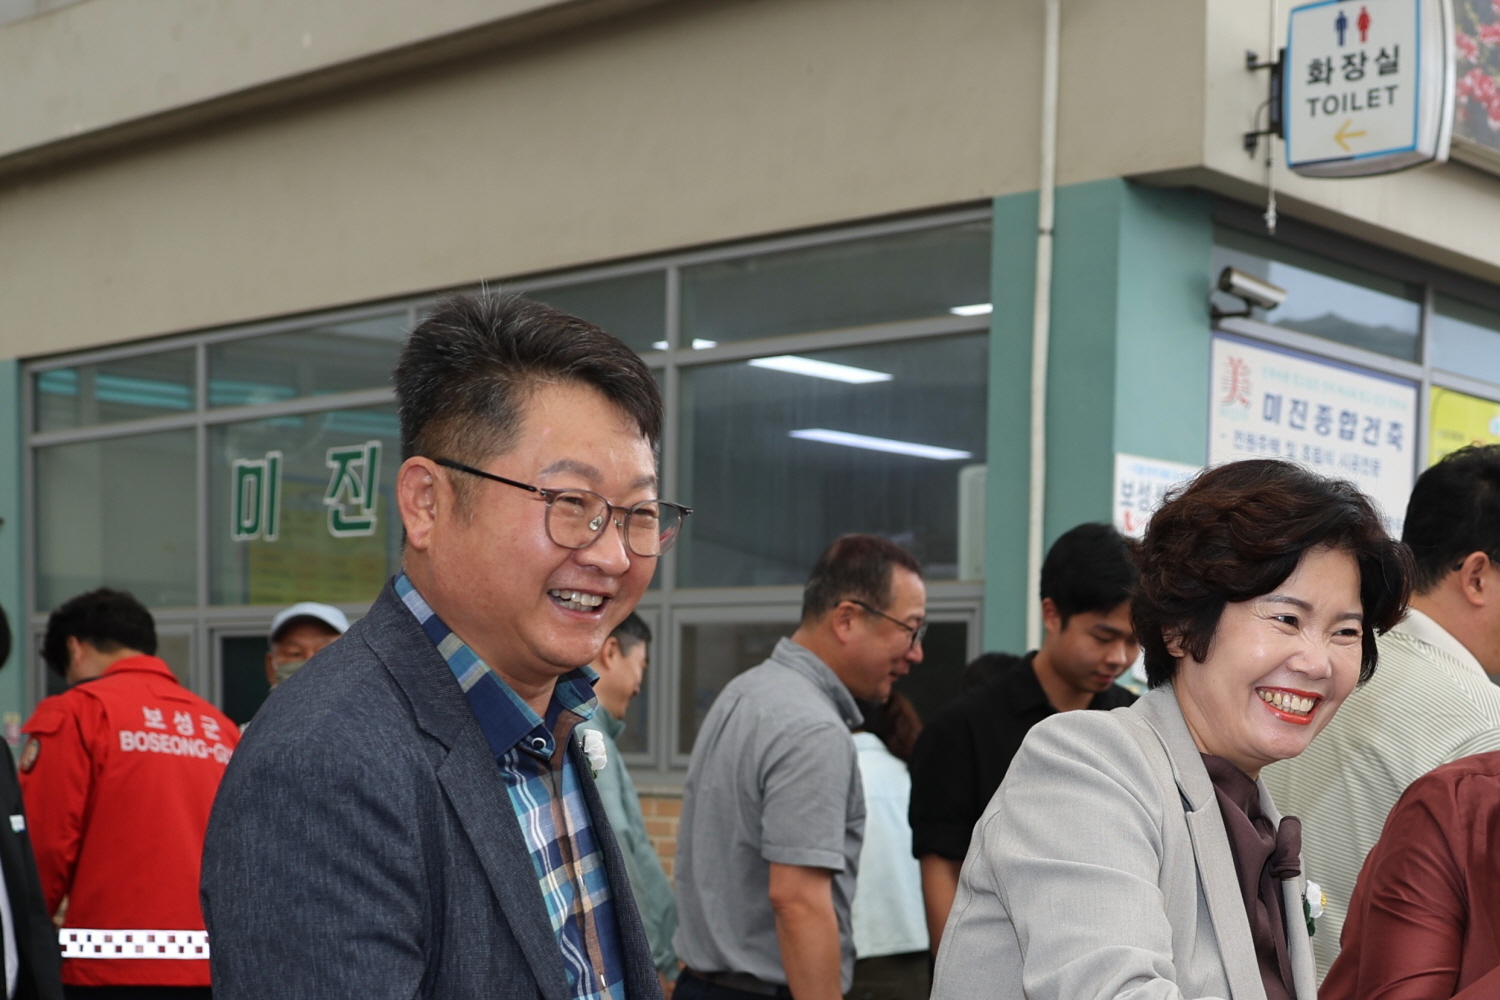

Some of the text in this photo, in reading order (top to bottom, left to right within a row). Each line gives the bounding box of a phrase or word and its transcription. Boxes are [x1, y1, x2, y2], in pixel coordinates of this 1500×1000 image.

[1306, 45, 1400, 85] 화장실
[1306, 85, 1399, 117] TOILET
[1262, 392, 1406, 451] 미진종합건축
[142, 706, 221, 741] 보성군
